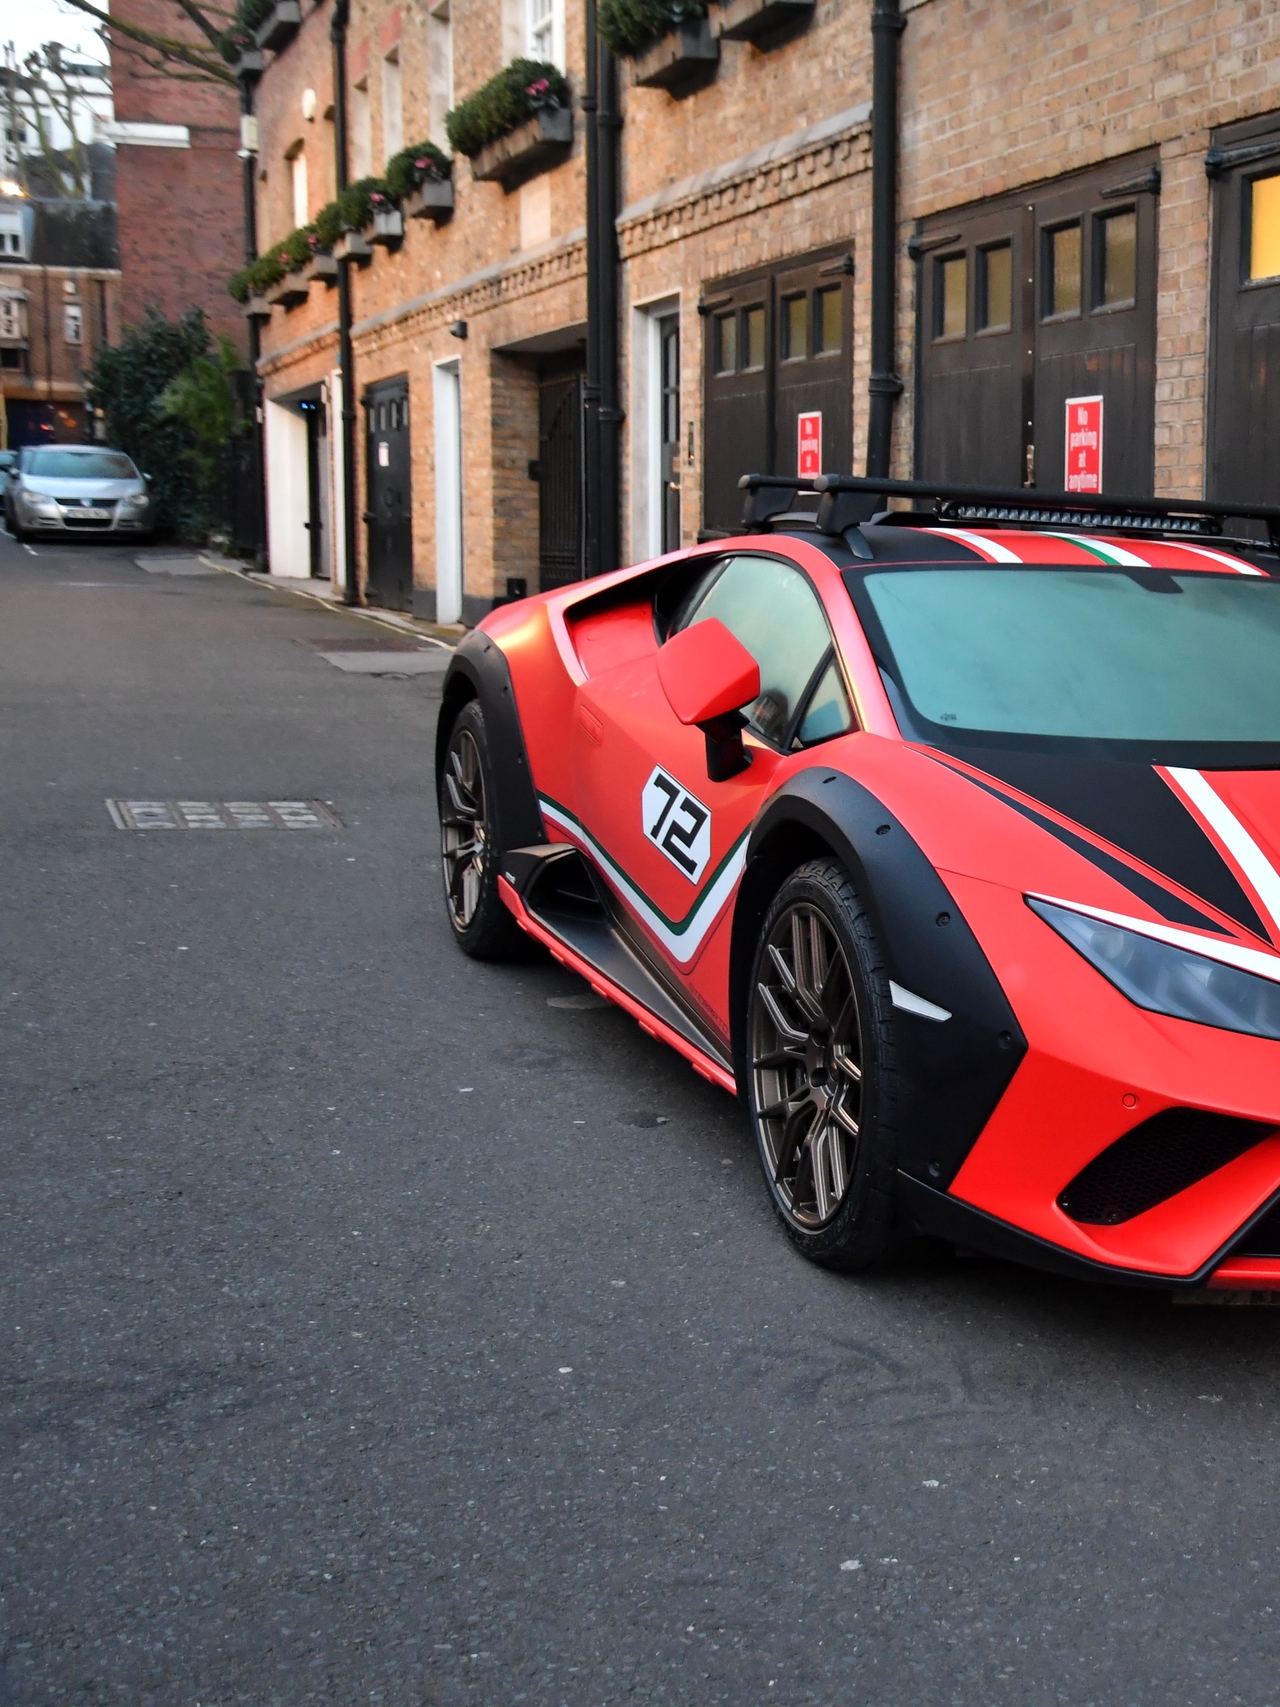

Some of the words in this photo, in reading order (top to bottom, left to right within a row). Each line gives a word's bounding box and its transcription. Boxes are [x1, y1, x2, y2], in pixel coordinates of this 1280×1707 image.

[1077, 407, 1088, 425] No
[1070, 427, 1098, 452] parking
[650, 773, 708, 876] 72
